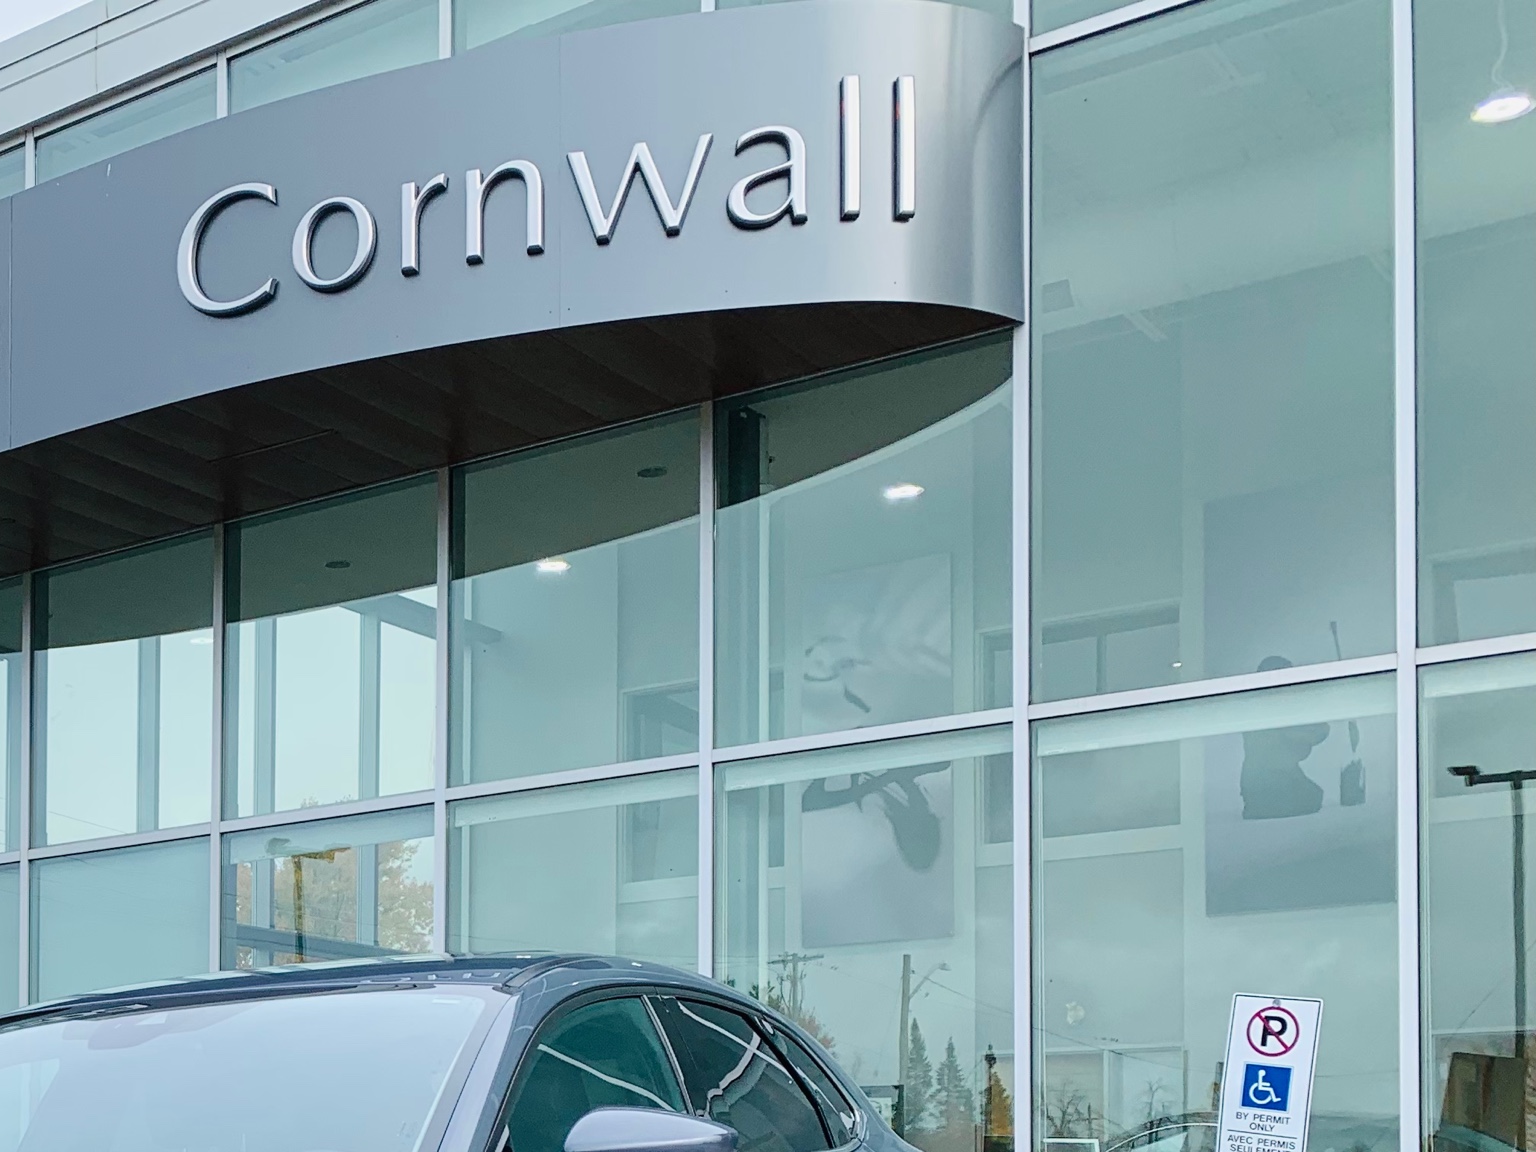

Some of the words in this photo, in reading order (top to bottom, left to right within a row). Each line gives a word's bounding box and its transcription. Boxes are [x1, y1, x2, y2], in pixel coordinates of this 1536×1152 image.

[176, 72, 917, 320] Cornwall
[1235, 1111, 1249, 1121] BY
[1253, 1113, 1291, 1125] PERMIT
[1249, 1122, 1275, 1132] ONLY
[1227, 1134, 1253, 1145] AVEC
[1257, 1138, 1296, 1150] PERMIS
